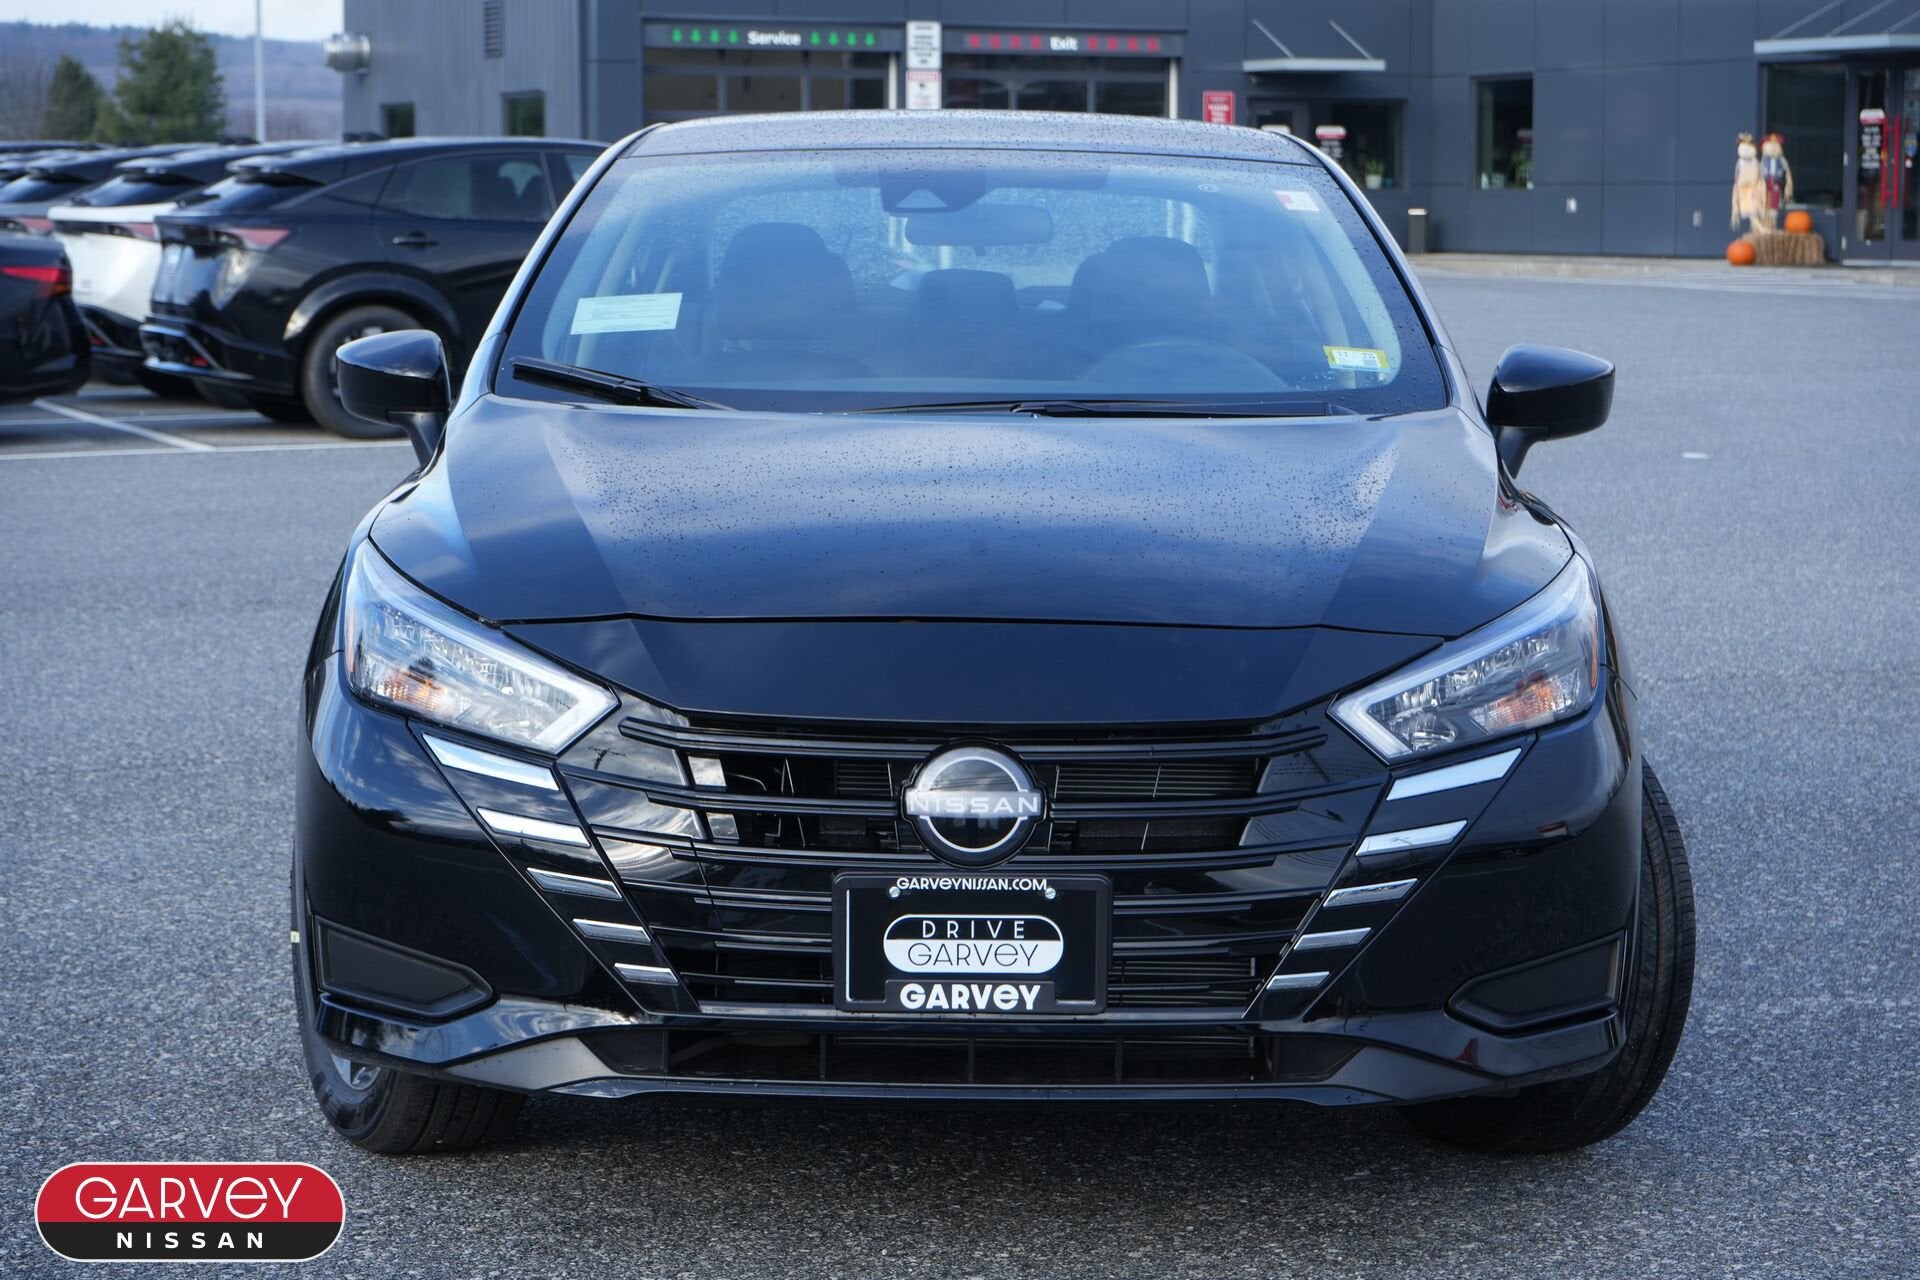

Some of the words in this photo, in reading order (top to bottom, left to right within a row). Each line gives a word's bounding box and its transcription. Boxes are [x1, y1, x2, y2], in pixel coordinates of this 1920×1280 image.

[747, 30, 801, 46] Service
[1050, 36, 1079, 51] Exit
[910, 796, 1038, 813] NISSAN
[922, 920, 1025, 939] DRIVE
